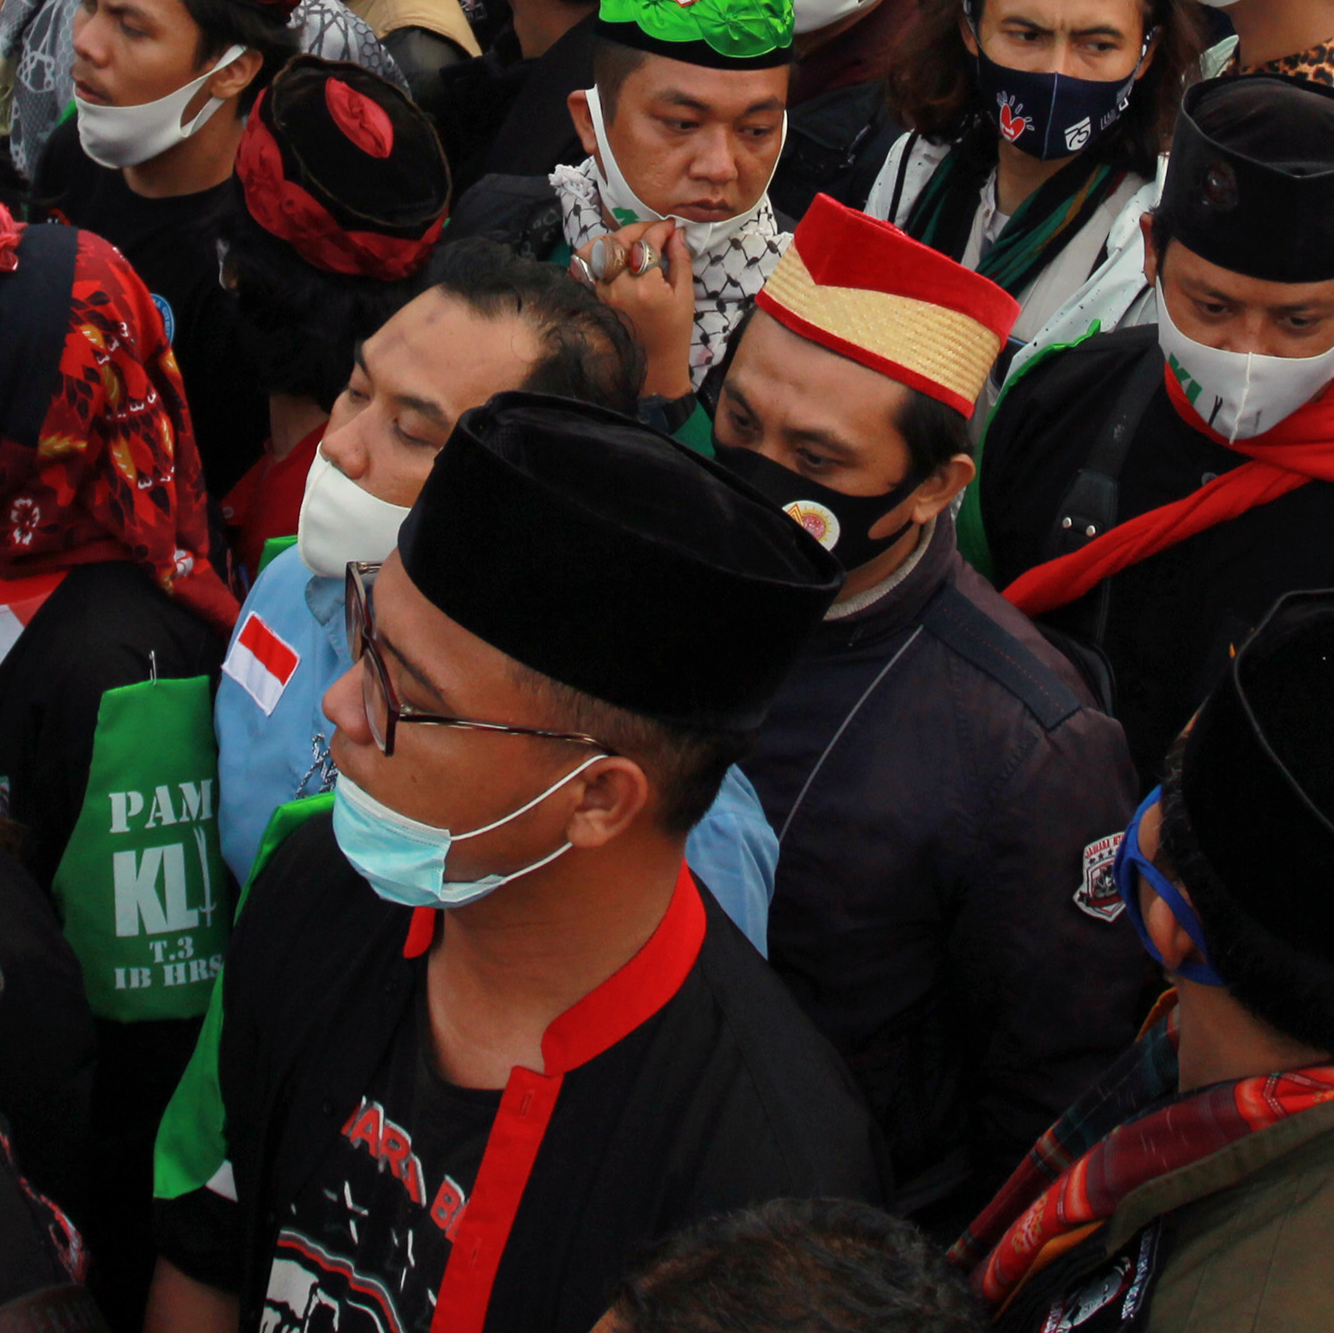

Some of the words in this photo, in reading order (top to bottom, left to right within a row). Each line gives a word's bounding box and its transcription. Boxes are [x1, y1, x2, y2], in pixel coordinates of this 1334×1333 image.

[108, 779, 213, 833] PAM
[114, 967, 152, 989] IB
[163, 954, 223, 987] HRS
[149, 936, 194, 963] T.3
[340, 1095, 427, 1209] ARA
